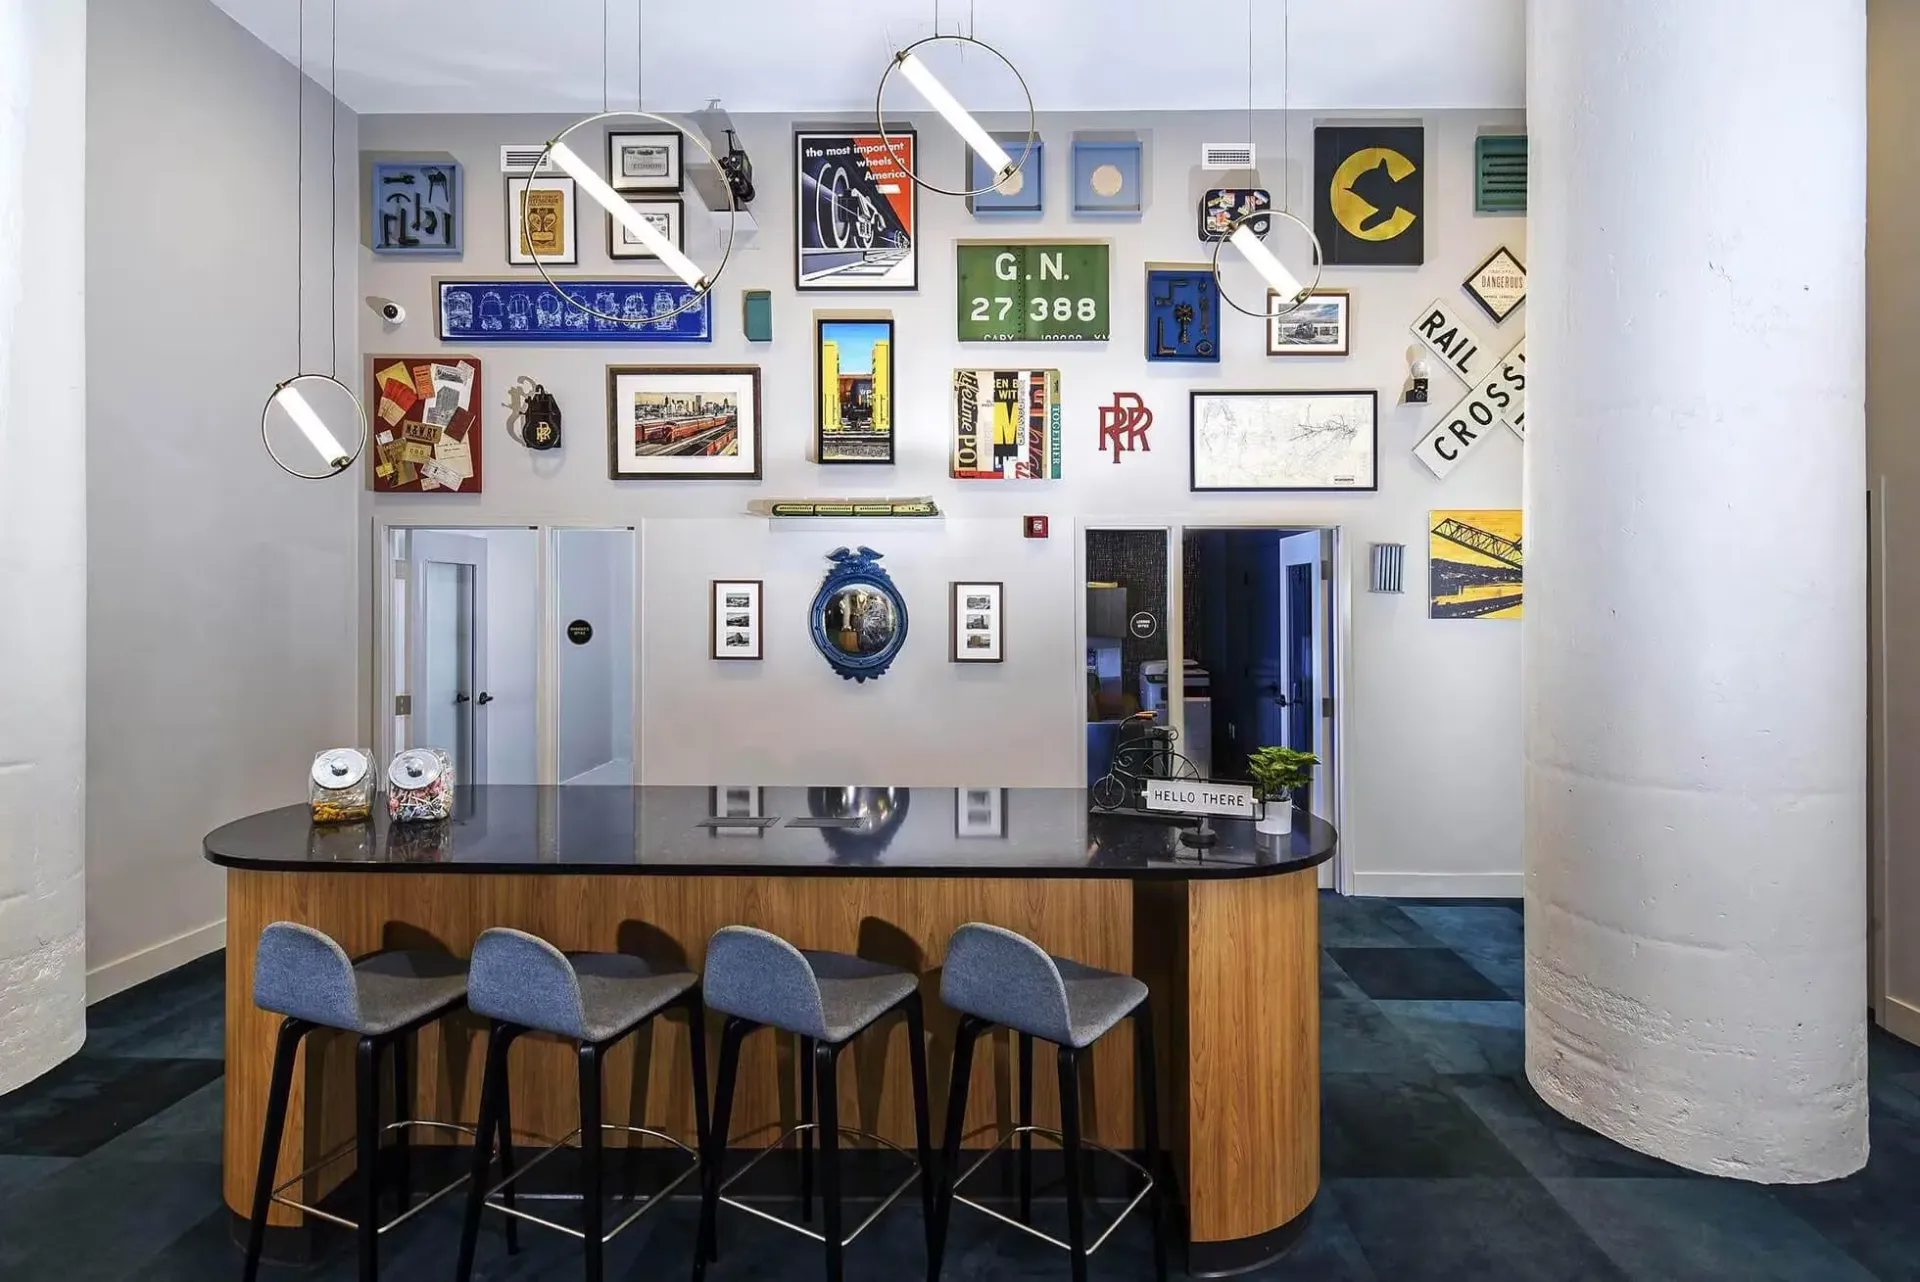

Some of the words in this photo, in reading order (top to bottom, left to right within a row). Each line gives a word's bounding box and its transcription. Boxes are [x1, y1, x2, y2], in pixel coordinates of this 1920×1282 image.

[806, 147, 823, 157] the
[826, 146, 851, 156] most
[856, 156, 892, 168] wheels
[864, 170, 906, 181] America
[1481, 275, 1523, 289] DANGEROUS
[970, 297, 1014, 321] 27
[1029, 297, 1096, 322] 388
[1418, 309, 1478, 375] RAIL
[1051, 407, 1061, 465] TOGETHER
[1154, 790, 1196, 803] HELLO
[1202, 792, 1245, 807] THERE
